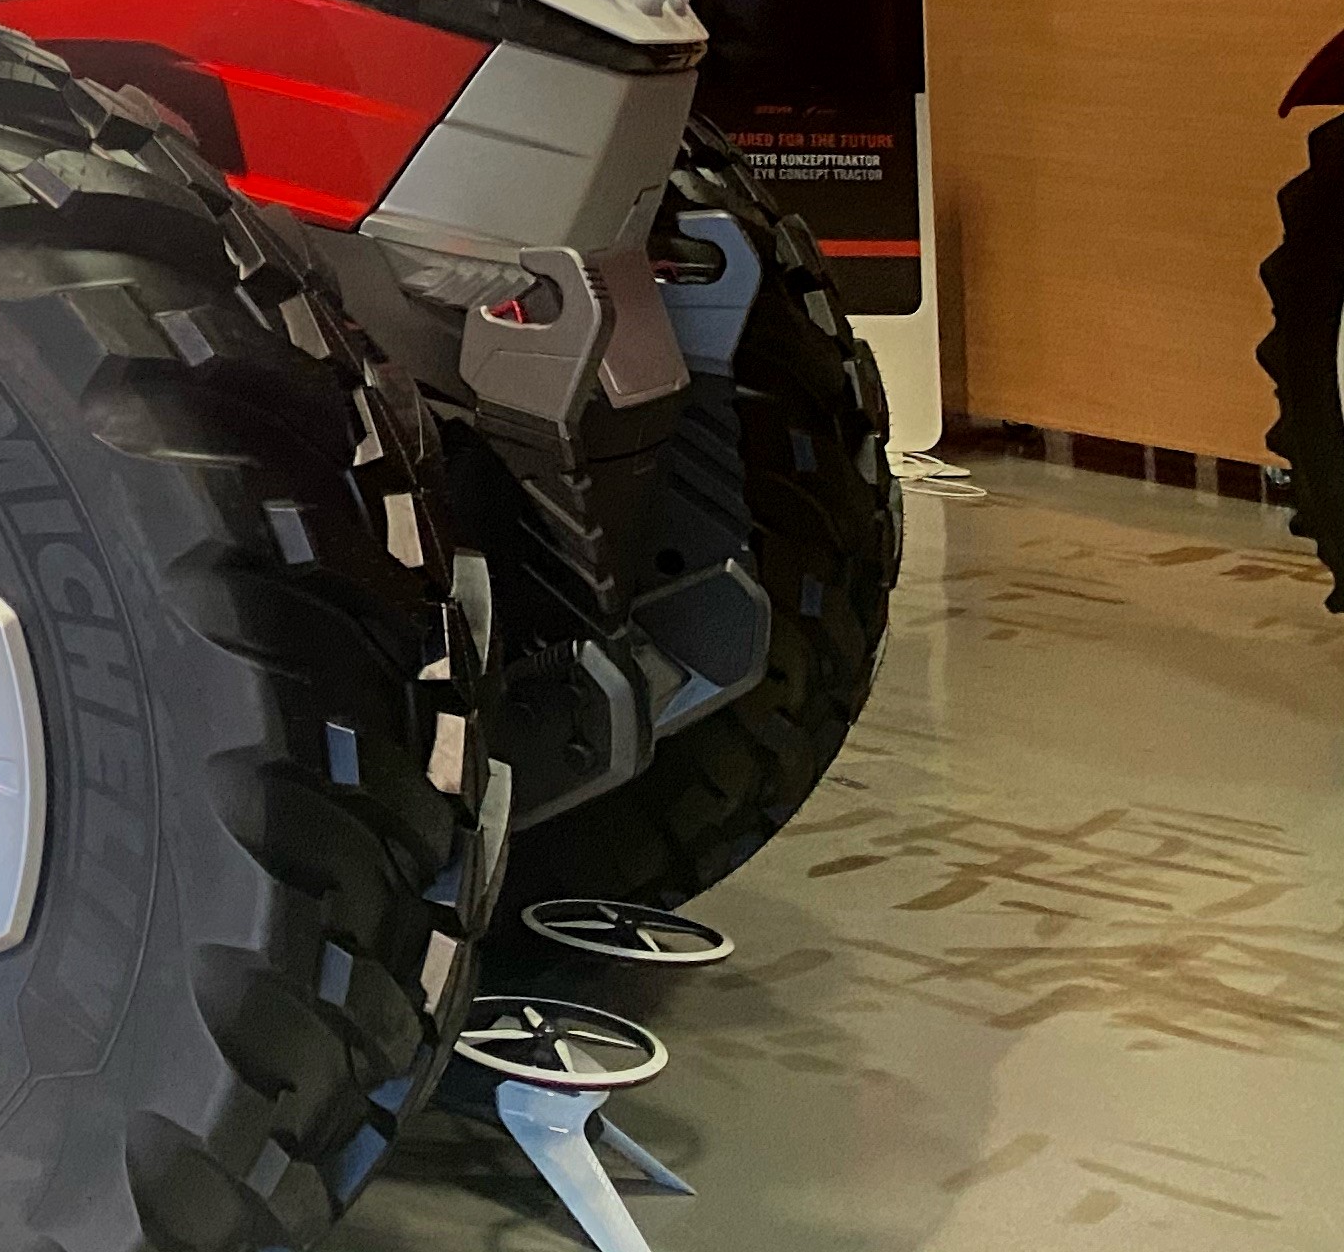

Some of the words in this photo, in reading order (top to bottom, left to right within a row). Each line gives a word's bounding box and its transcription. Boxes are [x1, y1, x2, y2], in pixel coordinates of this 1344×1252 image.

[779, 133, 804, 147] FOR
[811, 133, 836, 148] THE
[780, 154, 881, 166] KONZEPTTRAKTOR
[779, 169, 829, 180] CONCEPT
[834, 169, 883, 181] TRACTOR
